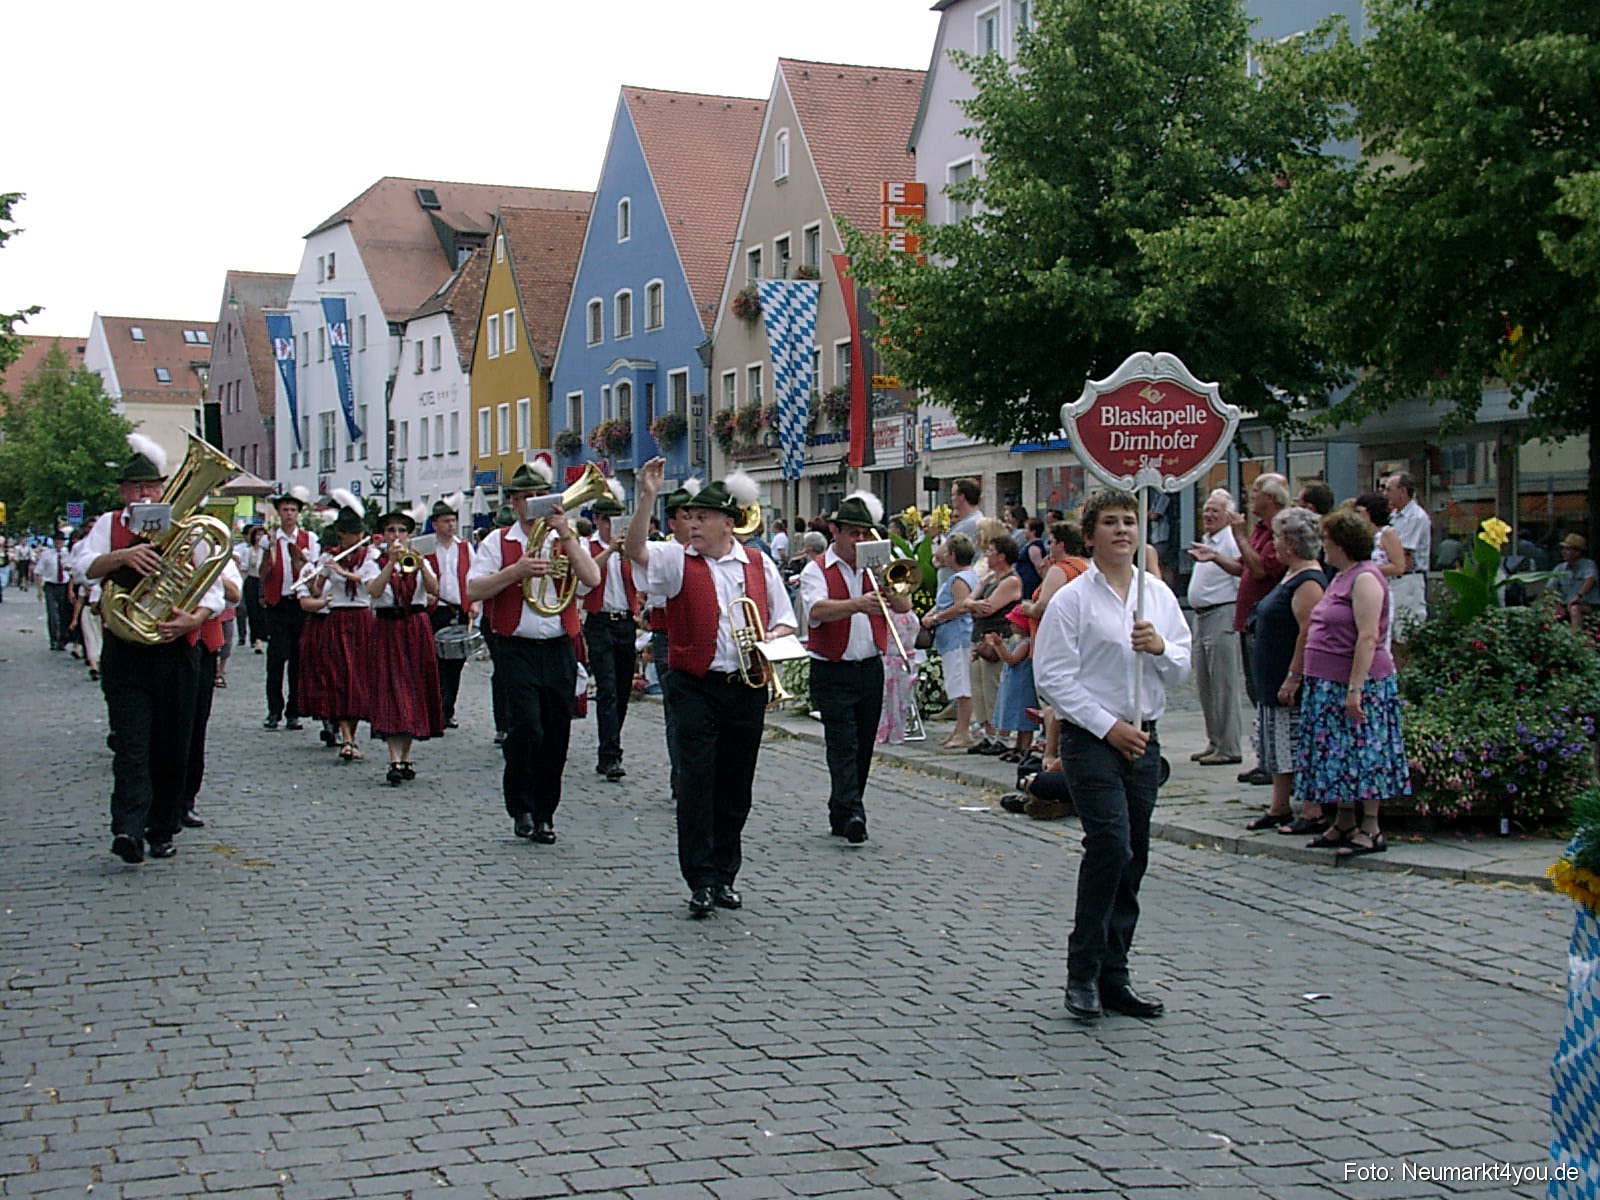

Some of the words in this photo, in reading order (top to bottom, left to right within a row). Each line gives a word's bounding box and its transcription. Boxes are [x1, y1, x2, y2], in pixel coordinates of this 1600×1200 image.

[418, 389, 436, 407] HOTEL
[1100, 404, 1207, 429] Blaskapelle
[905, 416, 914, 466] KINO
[1109, 430, 1199, 452] Dirnhofer
